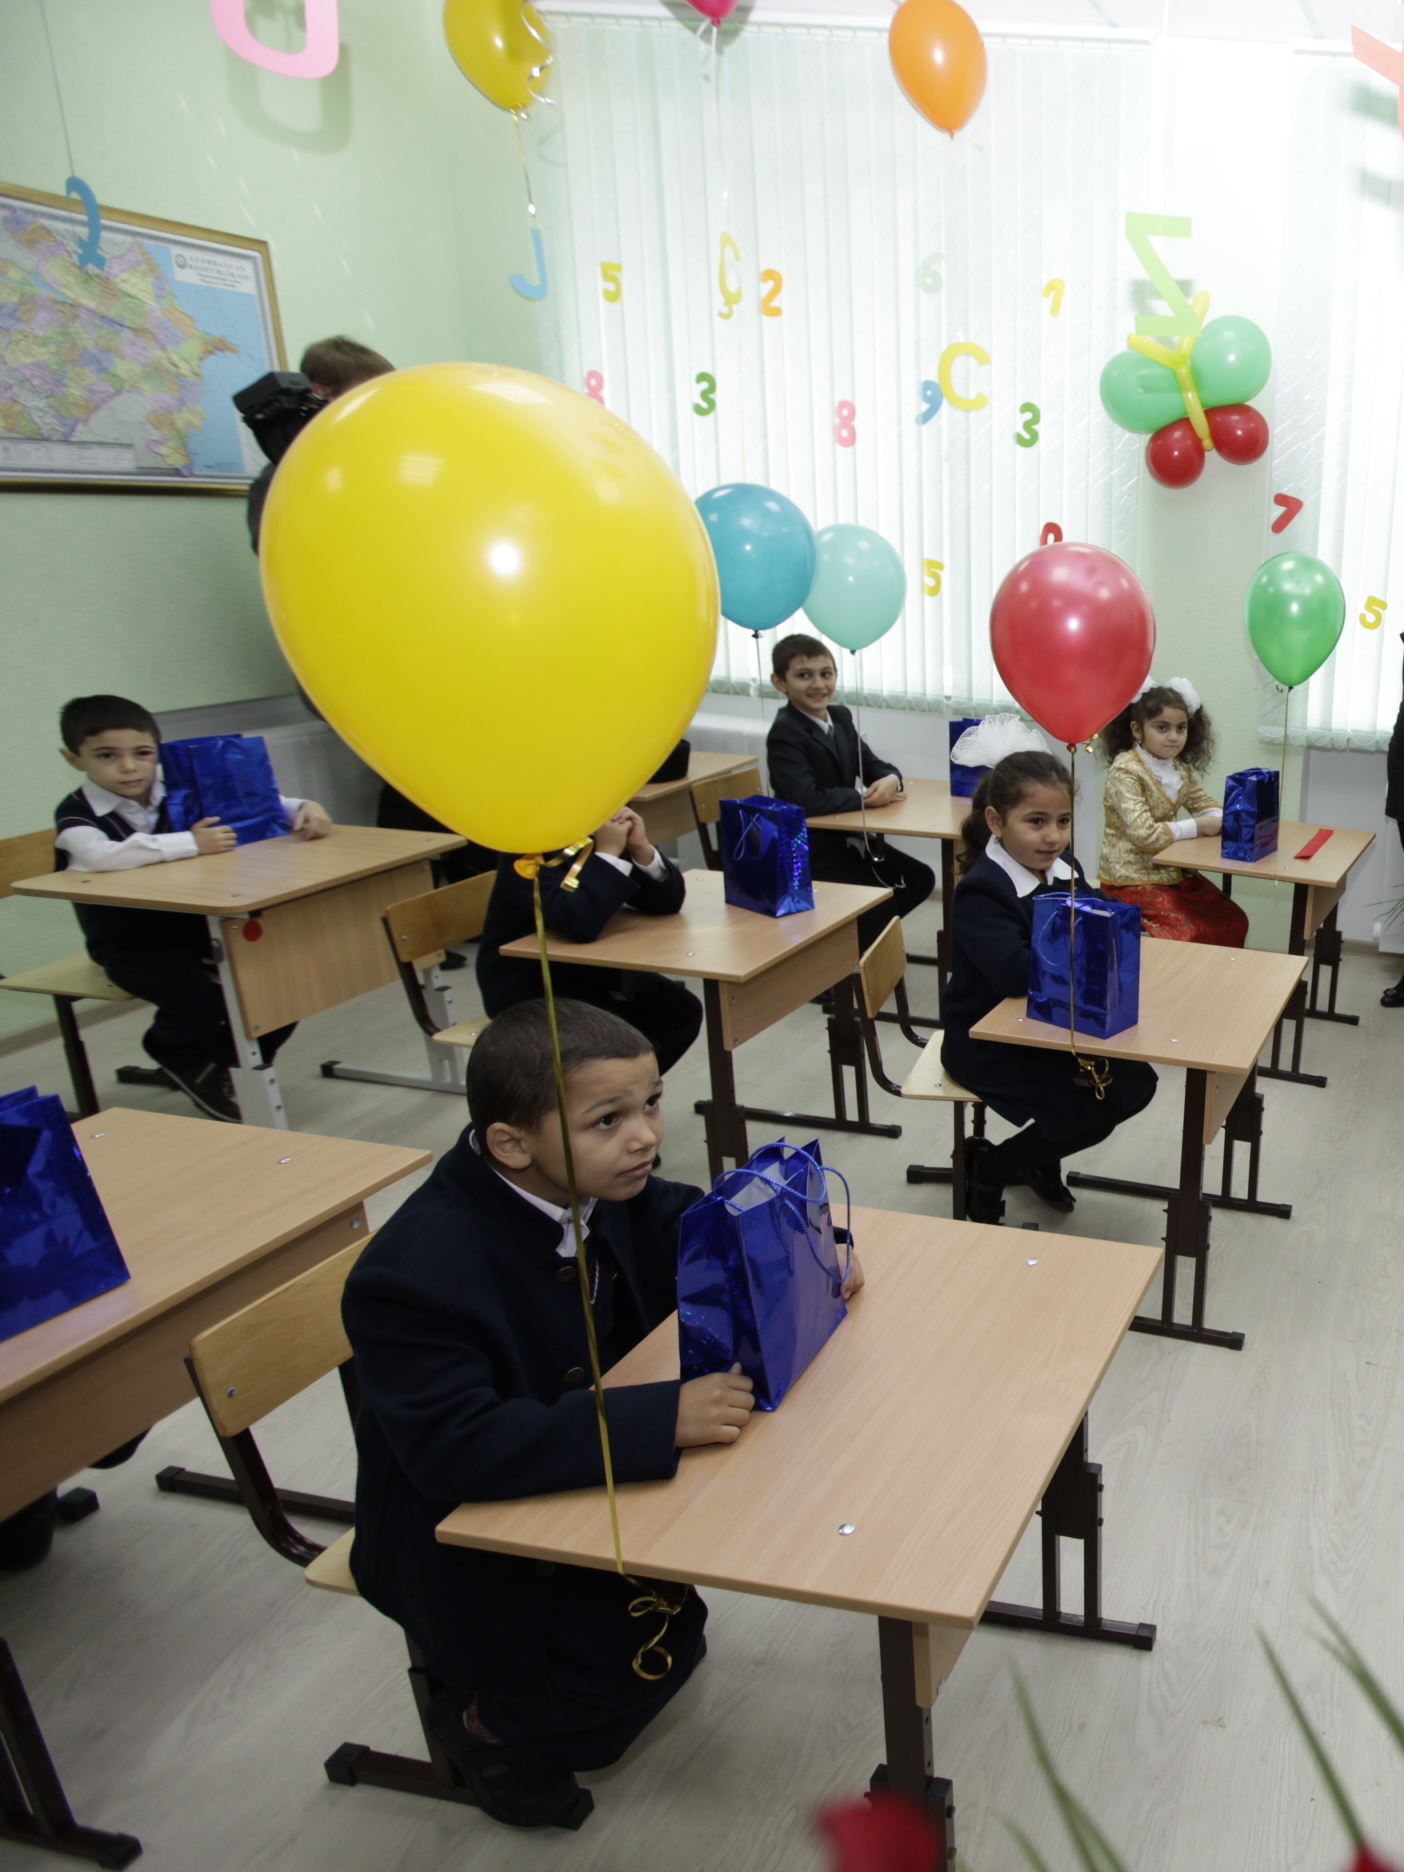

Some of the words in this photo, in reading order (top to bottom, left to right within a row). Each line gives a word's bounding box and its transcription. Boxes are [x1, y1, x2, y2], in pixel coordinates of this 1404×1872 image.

[600, 261, 622, 304] 5
[760, 268, 784, 318] 2
[692, 371, 716, 417] 3
[938, 341, 992, 412] C
[834, 399, 857, 448] 8
[1012, 401, 1041, 449] 3
[922, 557, 945, 598] 5
[1358, 595, 1388, 631] 5
